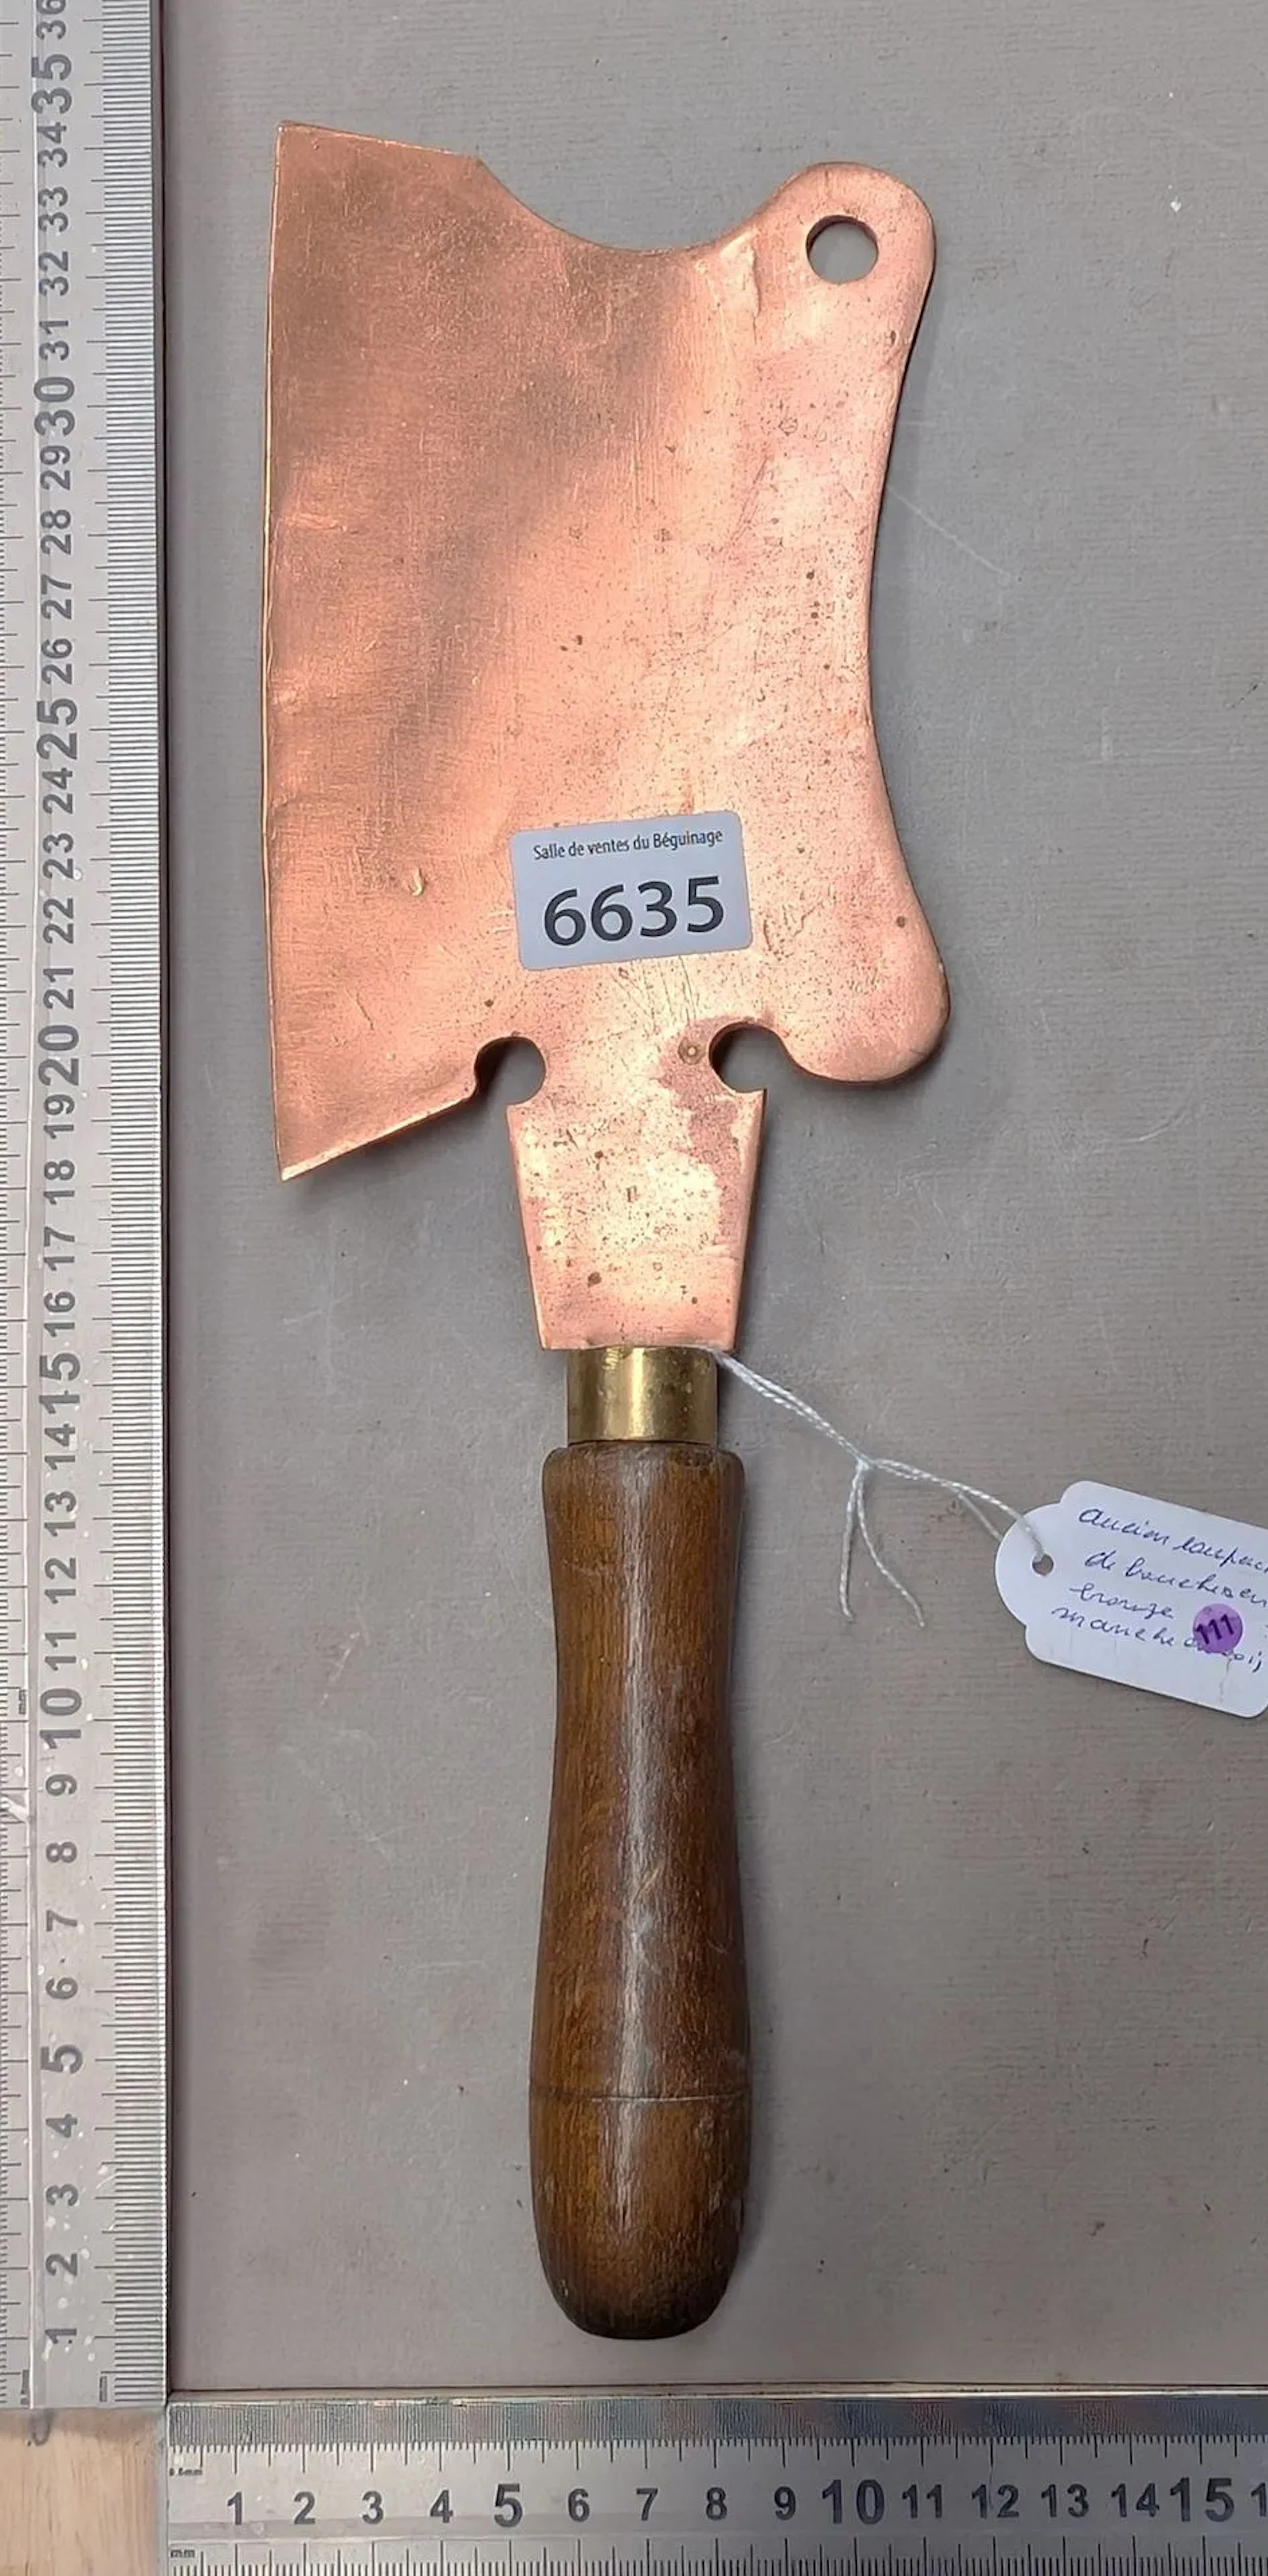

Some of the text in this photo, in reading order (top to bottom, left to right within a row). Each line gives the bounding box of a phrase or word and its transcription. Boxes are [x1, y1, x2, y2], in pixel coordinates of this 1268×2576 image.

[31, 54, 72, 114] 35
[37, 122, 67, 168] 34
[38, 187, 68, 232] 33
[38, 251, 69, 296] 32
[39, 320, 69, 361] 31
[34, 377, 75, 436] 30
[40, 446, 70, 491] 29
[40, 510, 71, 556] 28
[41, 574, 71, 620] 27
[41, 639, 72, 684] 26
[36, 699, 77, 760] 25
[42, 768, 73, 814] 24
[42, 833, 74, 879] 23
[534, 830, 722, 859] Salle de ventes du Béguinage
[43, 898, 74, 944] 22
[544, 876, 723, 946] 6635
[43, 968, 74, 1009] 21
[38, 1025, 79, 1086] 20
[43, 1095, 75, 1139] 19
[43, 1160, 75, 1205] 18
[43, 1227, 75, 1271] 17
[43, 1292, 75, 1337] 16
[39, 1353, 80, 1414] 15
[45, 1424, 75, 1470] 14
[44, 1491, 76, 1537] 13
[45, 1558, 76, 1604] 12
[45, 1633, 76, 1671] 11
[1196, 1614, 1234, 1645] 111
[40, 1688, 81, 1749] 10
[46, 1774, 77, 1796] 9
[46, 1842, 77, 1863] 8
[46, 1910, 77, 1932] 7
[46, 1978, 78, 2000] 6
[41, 2045, 81, 2073] 5
[46, 2114, 77, 2138] 4
[46, 2184, 78, 2206] 3
[46, 2253, 77, 2276] 2
[45, 2328, 77, 2344] 1
[227, 2492, 242, 2525] 1
[294, 2491, 316, 2525] 2
[362, 2491, 383, 2525] 3
[430, 2490, 453, 2523] 4
[494, 2483, 522, 2528] 5
[568, 2489, 589, 2522] 6
[636, 2488, 658, 2521] 7
[706, 2488, 727, 2520] 8
[774, 2487, 795, 2520] 9
[822, 2480, 884, 2524] 10
[902, 2485, 942, 2518] 11
[972, 2485, 1019, 2517] 12
[1041, 2484, 1089, 2517] 13
[1111, 2484, 1159, 2517] 14
[1170, 2477, 1234, 2522] 15
